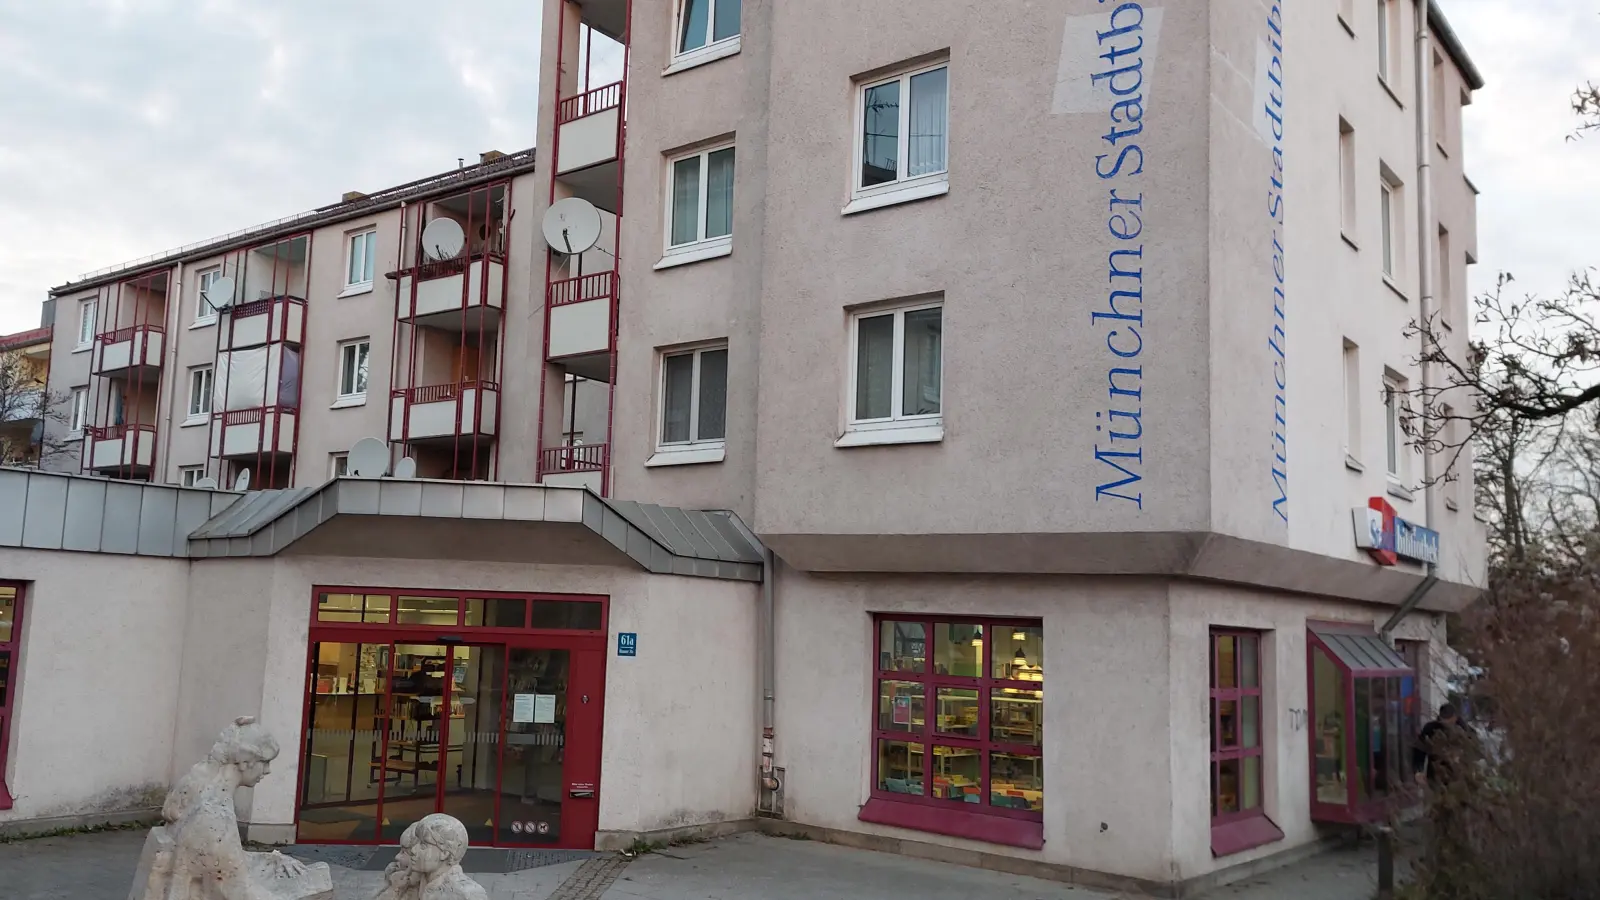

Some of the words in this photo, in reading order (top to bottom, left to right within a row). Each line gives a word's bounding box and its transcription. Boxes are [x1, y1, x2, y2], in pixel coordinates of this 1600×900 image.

[1090, 0, 1144, 180] Stadtb
[1264, 0, 1286, 227] Stadtbib
[1090, 187, 1144, 509] Münchner
[1268, 229, 1288, 522] Münchner
[620, 634, 634, 646] 61a
